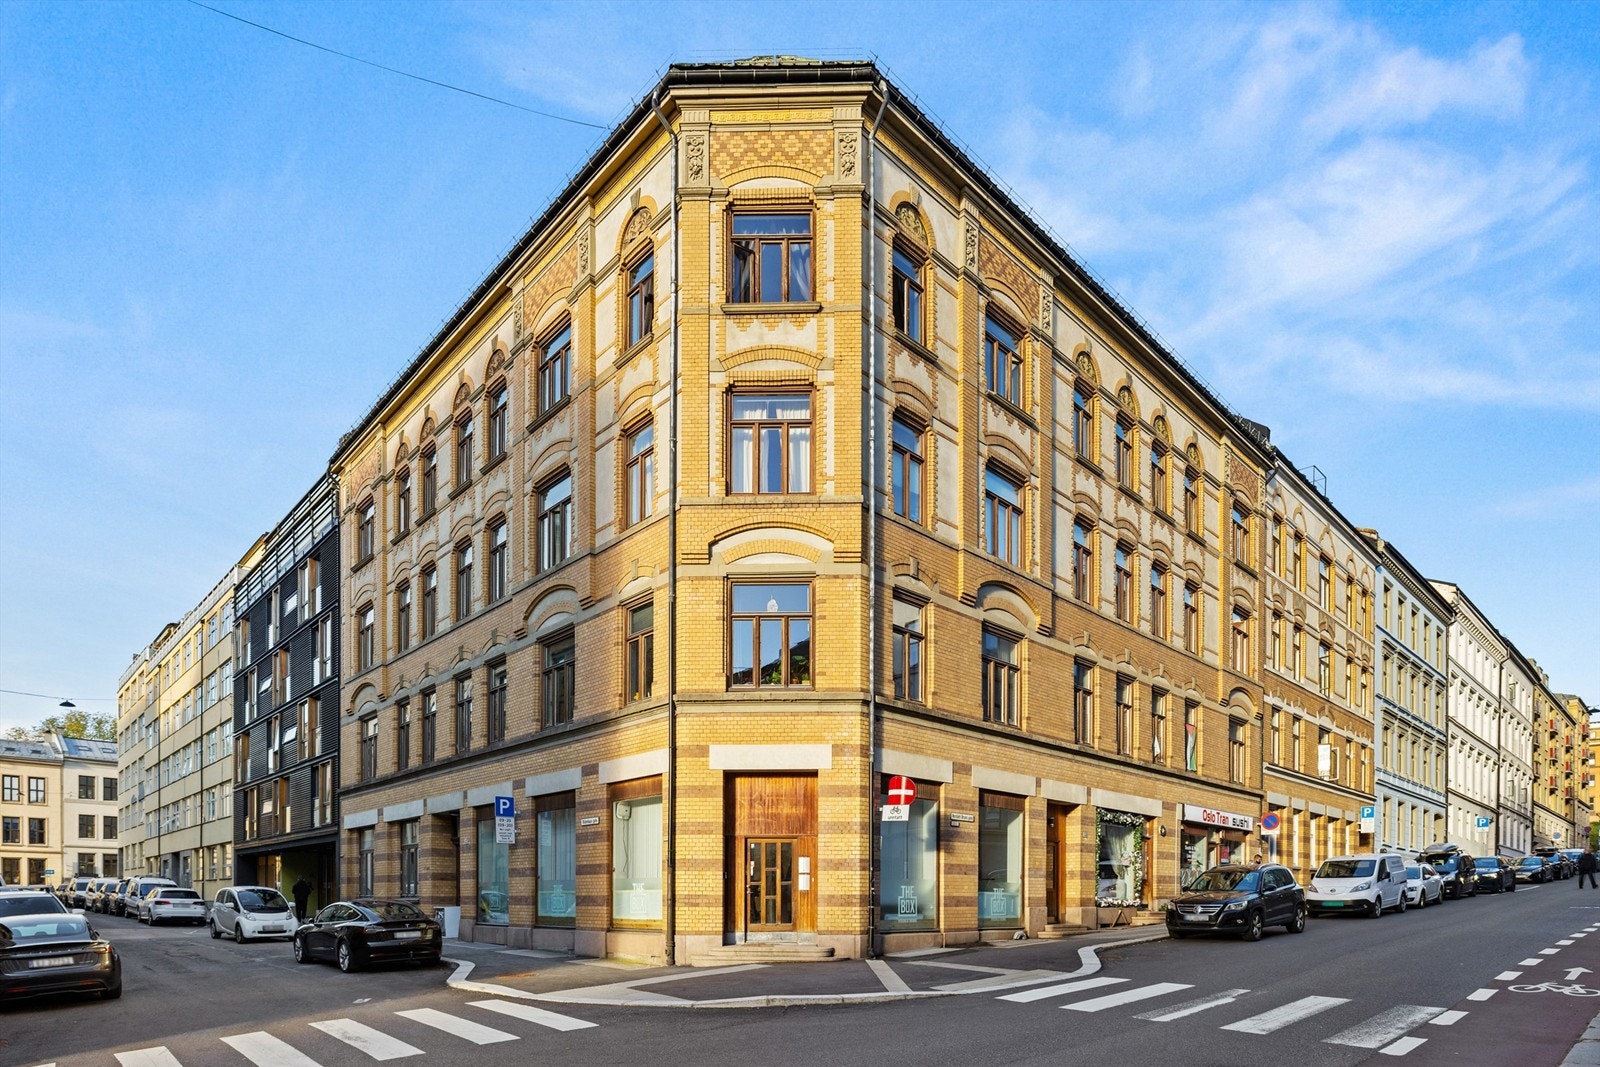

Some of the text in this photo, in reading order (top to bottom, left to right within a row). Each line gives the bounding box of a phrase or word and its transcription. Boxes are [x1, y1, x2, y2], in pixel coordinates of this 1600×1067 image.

[500, 799, 510, 814] P
[1364, 808, 1372, 817] P
[1202, 810, 1250, 828] Oslo Tran sushi
[900, 886, 914, 898] THE
[900, 900, 914, 914] BOX
